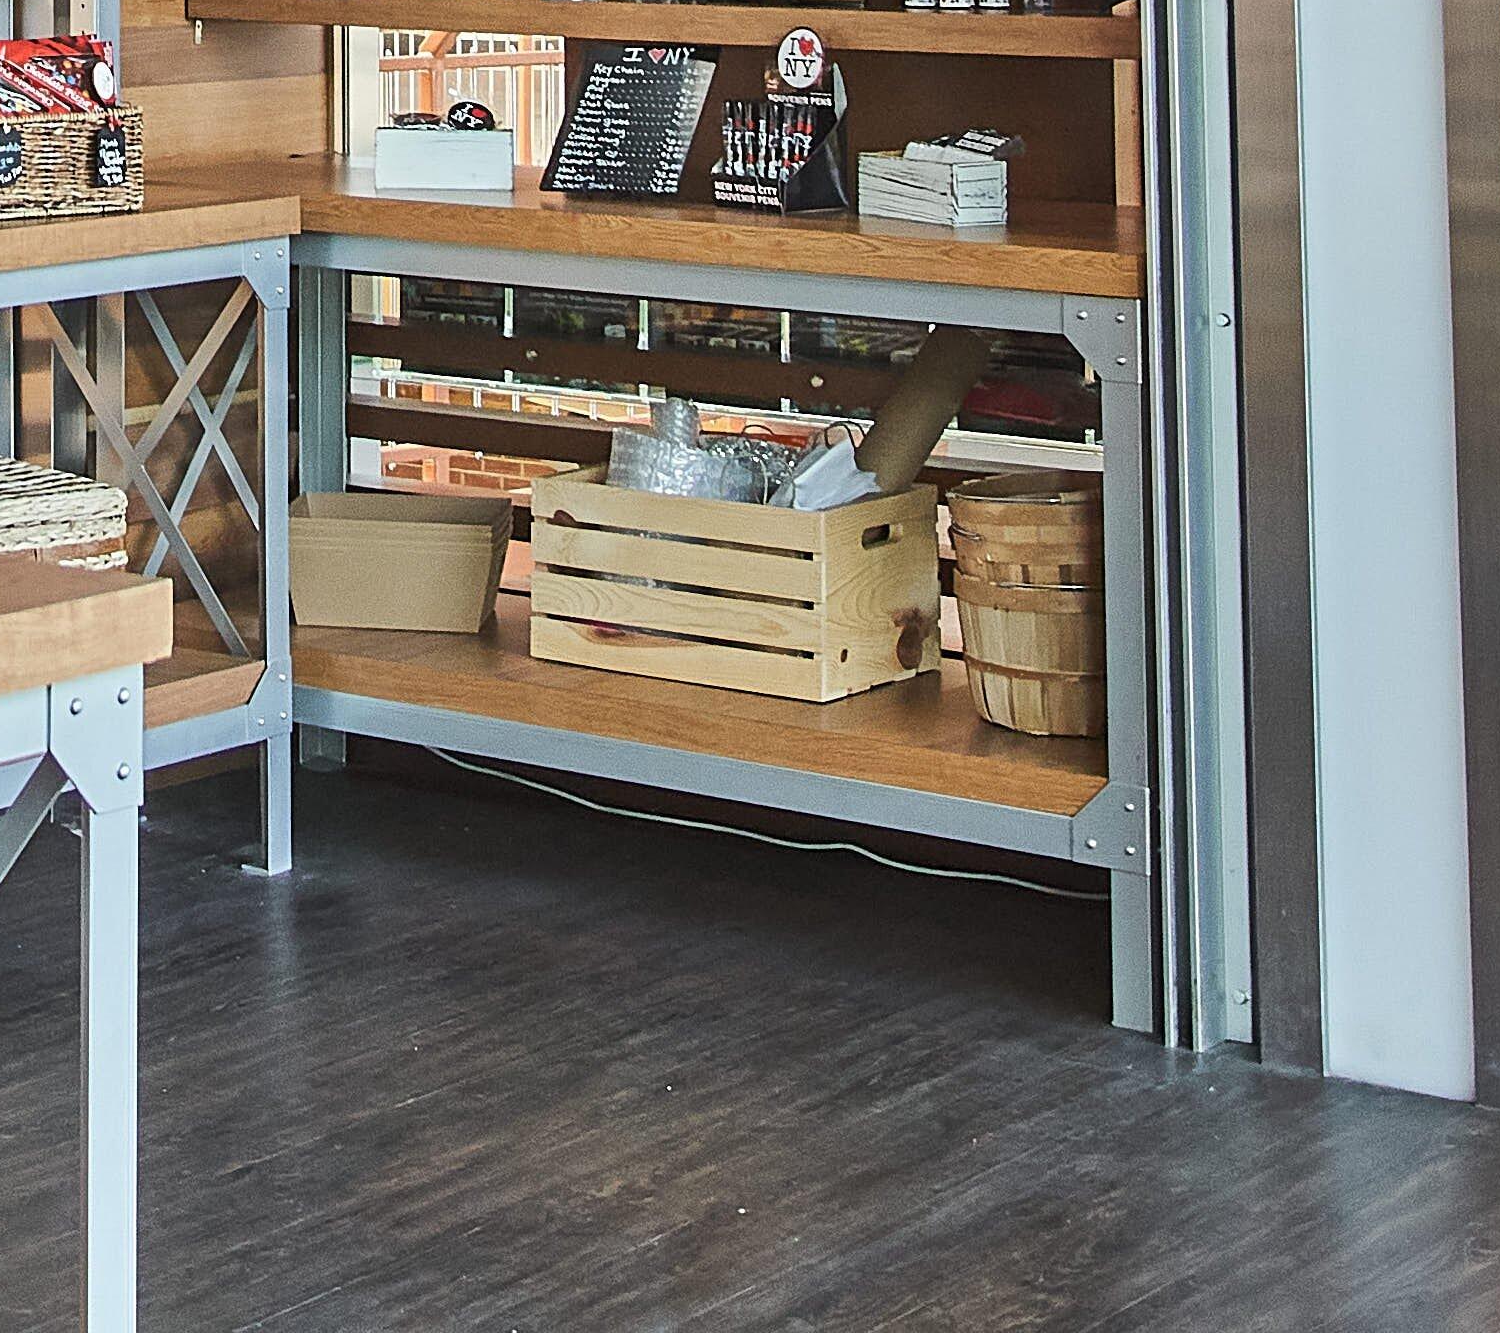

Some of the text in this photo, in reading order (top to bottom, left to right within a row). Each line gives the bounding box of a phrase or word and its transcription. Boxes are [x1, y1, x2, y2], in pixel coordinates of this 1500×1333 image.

[623, 47, 645, 62] I
[789, 37, 798, 55] I
[784, 58, 816, 78] NY
